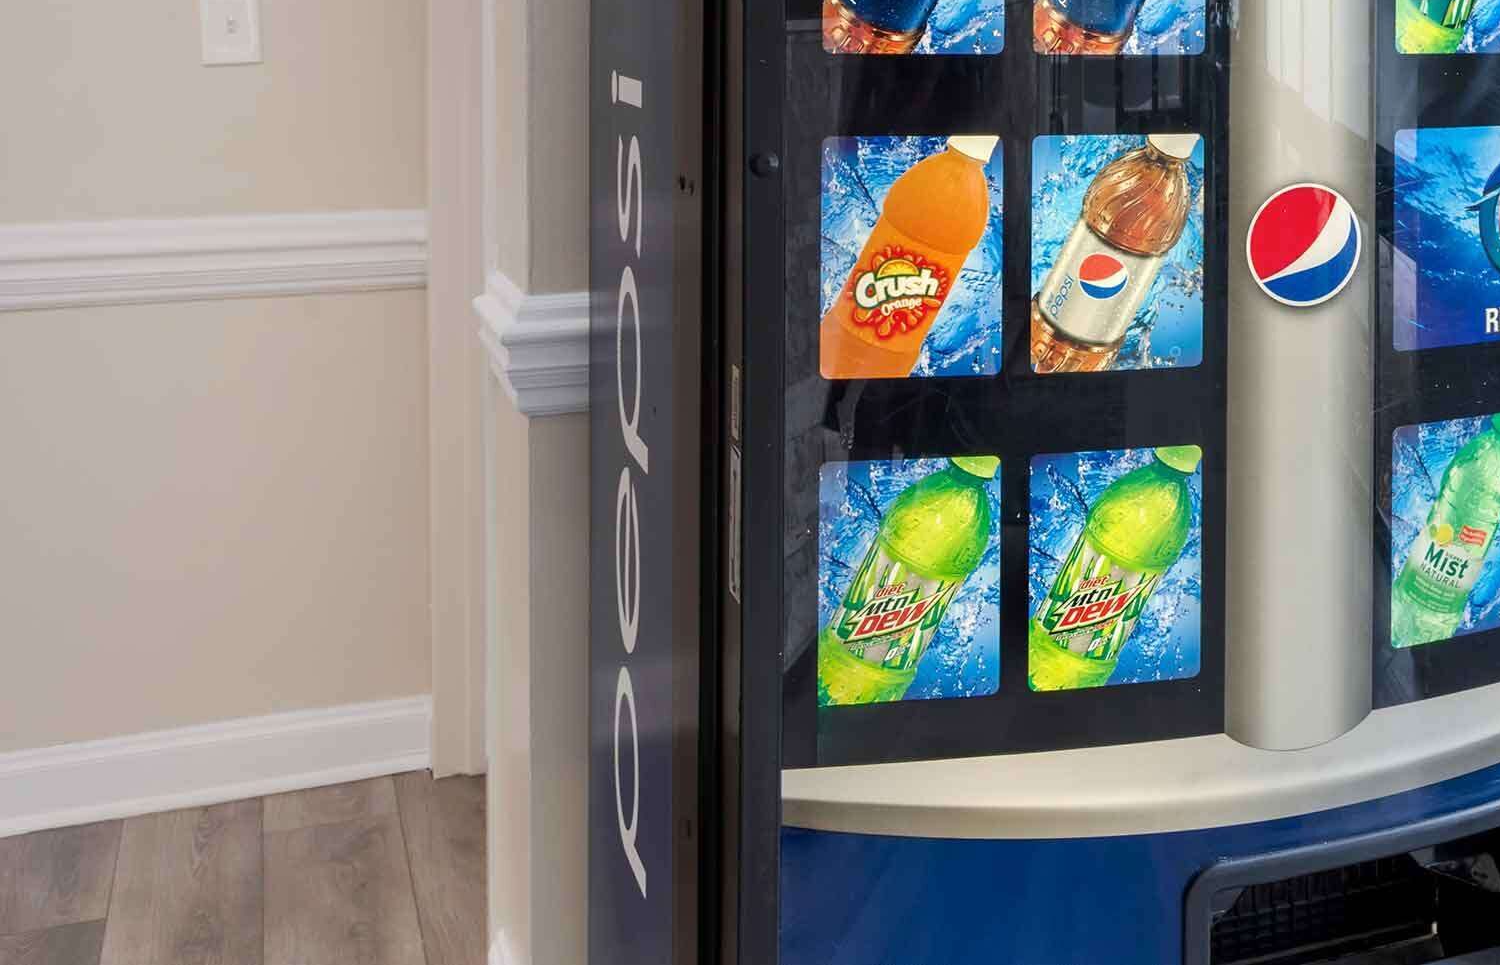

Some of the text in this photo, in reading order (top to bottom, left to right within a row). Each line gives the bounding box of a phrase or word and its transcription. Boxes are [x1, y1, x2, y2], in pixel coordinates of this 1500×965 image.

[855, 267, 939, 310] Crush
[1050, 273, 1074, 320] pepsi
[881, 296, 923, 317] Orange
[611, 69, 649, 900] pepsi
[1420, 562, 1461, 589] NATURAL
[1424, 541, 1469, 580] Mist
[859, 595, 910, 619] Mtn
[1063, 587, 1113, 610] Mtn
